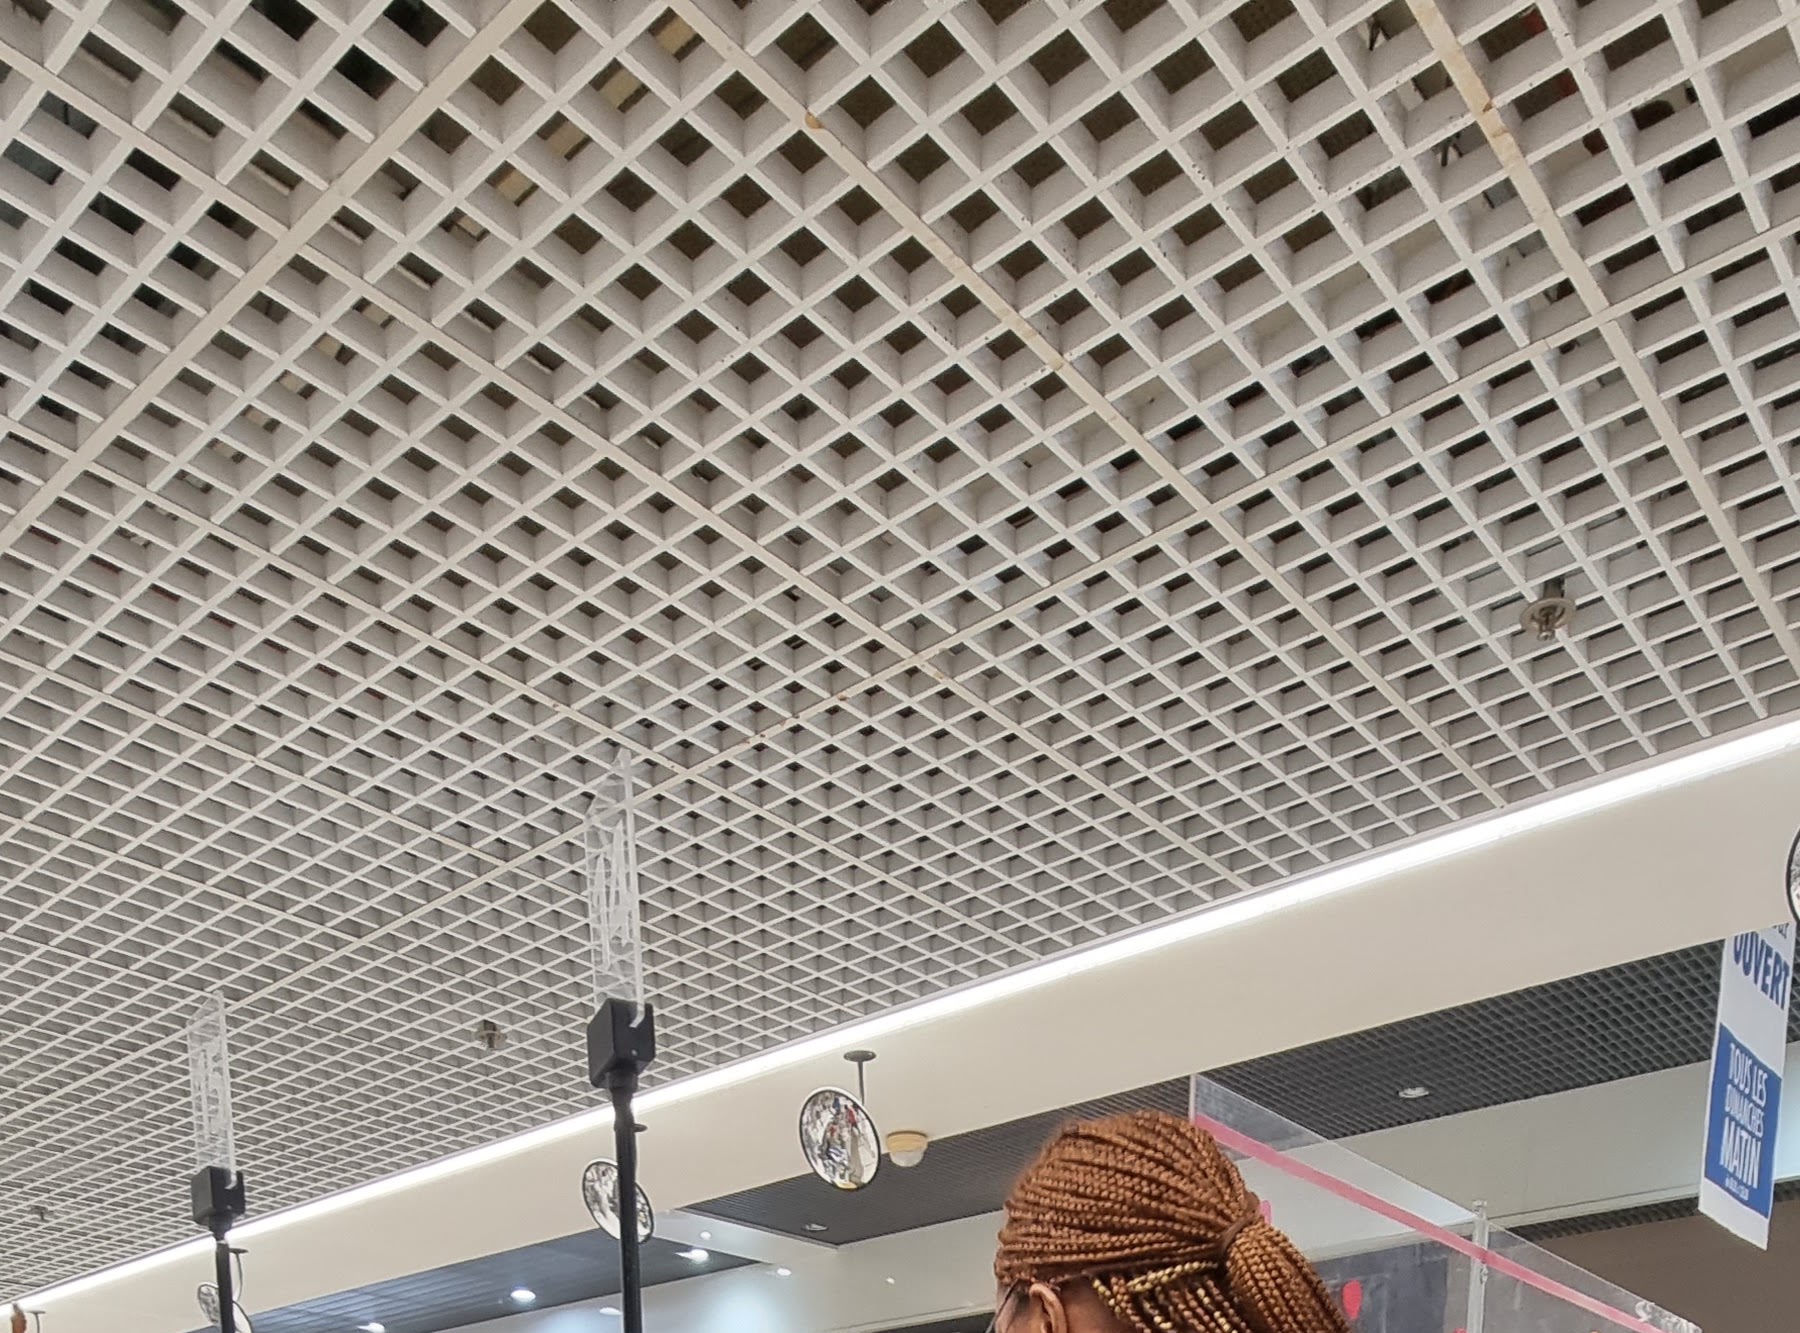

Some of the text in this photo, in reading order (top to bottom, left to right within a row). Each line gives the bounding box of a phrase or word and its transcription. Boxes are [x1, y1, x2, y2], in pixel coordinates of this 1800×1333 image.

[1730, 1042, 1768, 1108] TOUS LES
[1725, 1084, 1764, 1138] DIMANCHES
[1720, 1117, 1761, 1188] MATIN
